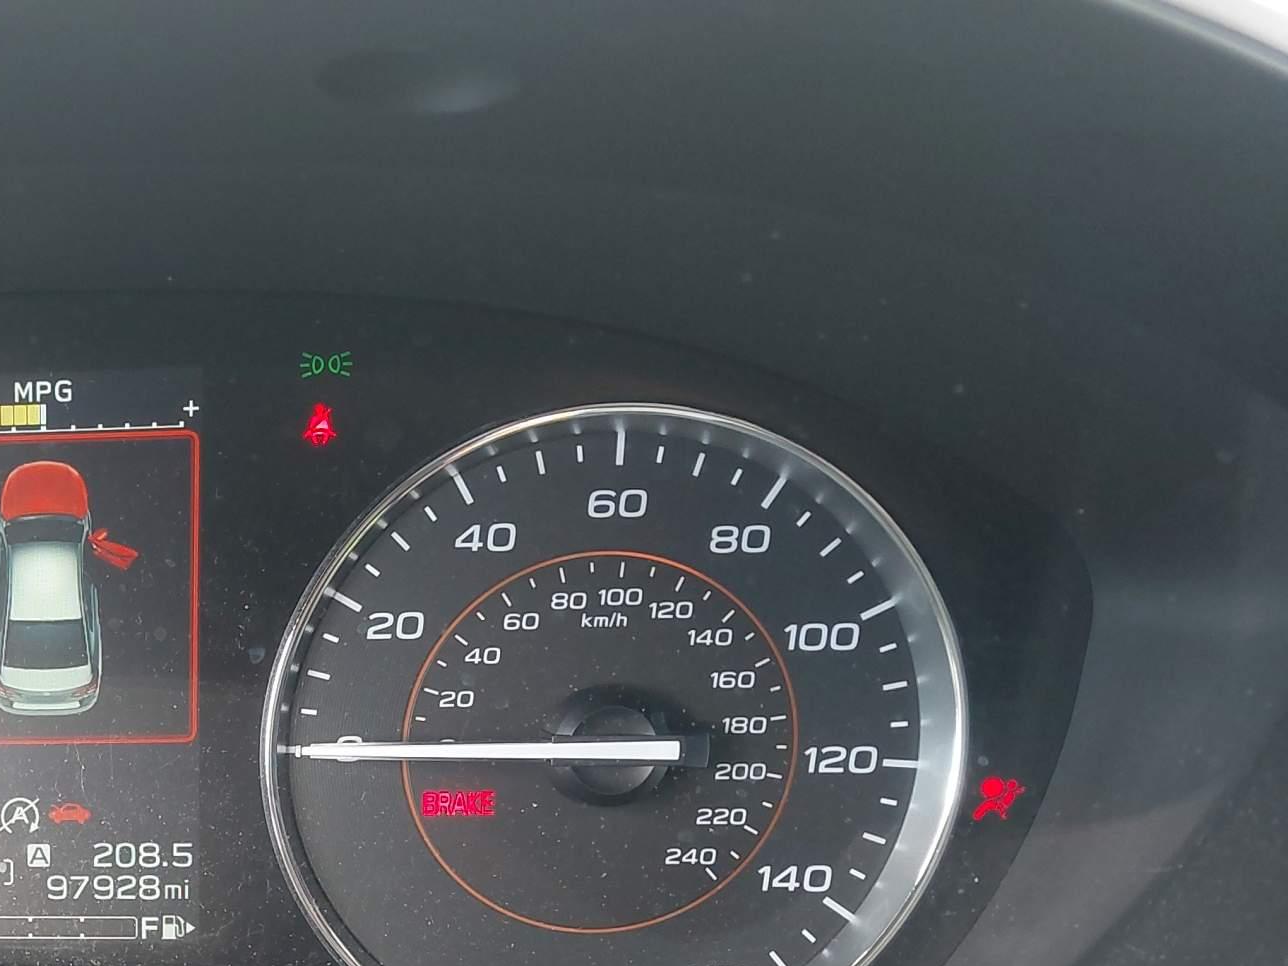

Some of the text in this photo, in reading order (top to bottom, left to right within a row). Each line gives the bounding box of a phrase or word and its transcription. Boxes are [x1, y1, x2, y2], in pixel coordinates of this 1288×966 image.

[14, 380, 73, 403] MPG
[587, 489, 647, 518] 60
[454, 522, 516, 552] 40
[709, 524, 771, 554] 80
[550, 591, 587, 610] 80
[598, 588, 643, 607] 100
[581, 611, 628, 628] km/h
[649, 601, 693, 619] 120
[366, 611, 424, 641] 20
[503, 611, 539, 630] 60
[687, 628, 733, 647] 140
[784, 623, 859, 652] 100
[465, 646, 501, 665] 40
[710, 670, 756, 689] 160
[439, 690, 474, 708] 20
[721, 715, 767, 734] 180
[804, 745, 878, 774] 120
[715, 762, 767, 781] 200
[422, 789, 497, 817] BRAKE
[696, 807, 746, 826] 220
[93, 843, 193, 868] 208.5
[665, 847, 716, 866] 240
[757, 864, 832, 893] 140
[141, 917, 159, 939] F
